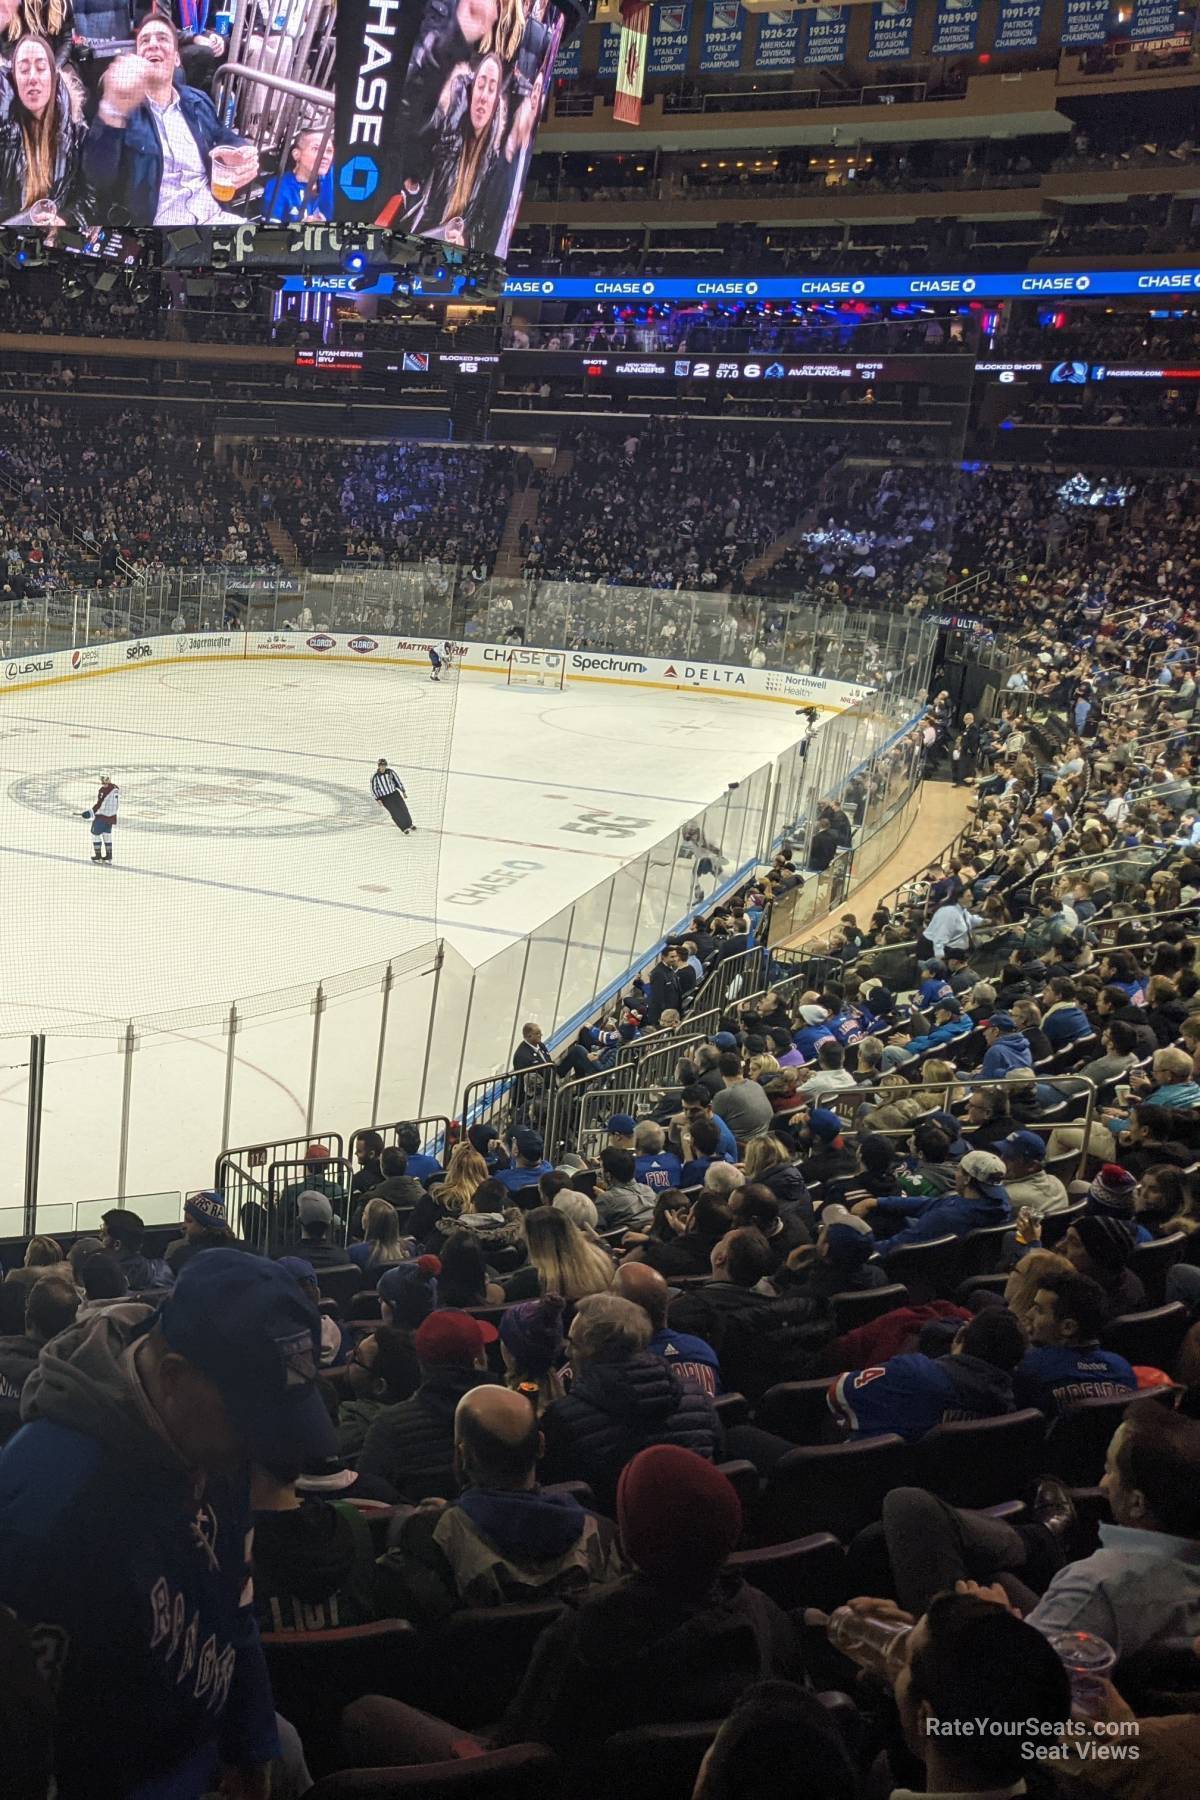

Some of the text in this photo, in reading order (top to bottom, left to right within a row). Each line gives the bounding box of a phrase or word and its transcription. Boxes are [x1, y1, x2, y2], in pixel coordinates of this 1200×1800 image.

[1068, 1, 1109, 13] 1991-92
[1137, 6, 1172, 16] ATLANTIC
[1002, 7, 1040, 18] 1991-92
[938, 12, 977, 24] 1989-90
[1068, 14, 1104, 24] REGULAR
[1138, 16, 1169, 26] DIVISION
[874, 18, 912, 30] 1941-42
[1003, 20, 1033, 29] PATRICK
[1069, 23, 1100, 32] SEASON
[761, 28, 798, 39] 1926-27
[809, 25, 846, 36] 1931-32
[940, 26, 970, 34] PATRICK
[1002, 29, 1033, 37] DIVISION
[1131, 24, 1174, 36] CHAMPIONS
[652, 35, 688, 46] 1939-40
[705, 32, 742, 43] 1993-94
[874, 31, 908, 40] REGULAR
[939, 34, 970, 43] DIVISION
[1061, 32, 1106, 42] CHAMPIONS
[760, 40, 795, 49] AMERICAN
[808, 37, 844, 46] AMERICAN
[876, 40, 904, 48] SEASON
[995, 37, 1037, 47] CHAMPIONS
[653, 47, 682, 56] STANLEY
[707, 44, 736, 53] STANLEY
[810, 46, 839, 55] DIVISION
[932, 42, 974, 52] CHAMPIONS
[713, 52, 727, 60] CUP
[762, 49, 791, 57] DIVISION
[869, 48, 910, 58] CHAMPIONS
[756, 57, 796, 66] CHAMPIONS
[804, 54, 844, 63] CHAMPIONS
[648, 63, 686, 73] CHAMPIONS
[700, 60, 740, 70] CHAMPIONS
[350, 0, 399, 146] HASE
[304, 278, 346, 289] HASE
[910, 281, 960, 292] CHASE
[1022, 278, 1074, 290] CHASE
[1138, 275, 1191, 288] CHASE
[504, 282, 540, 292] HASE
[595, 283, 640, 293] CHASE
[697, 283, 743, 294] CHASE
[801, 282, 847, 293] CHASE
[459, 363, 478, 373] 15
[693, 364, 710, 377] 2
[744, 364, 761, 377] 6
[716, 370, 738, 379] 57.0
[862, 371, 875, 379] 31
[999, 371, 1014, 382] 6
[310, 639, 333, 647] CLOROX
[351, 641, 375, 649] CLOROX
[484, 648, 541, 665] CHASE
[19, 660, 53, 674] LEXUS
[572, 654, 642, 673] Spectrum
[685, 667, 745, 684] DELTA
[785, 676, 827, 689] Northwell
[784, 686, 810, 697] Health
[444, 868, 529, 906] CHASE
[1103, 928, 1115, 938] 115
[839, 1103, 854, 1116] 114
[250, 1152, 265, 1165] 114
[645, 1170, 670, 1186] FOX
